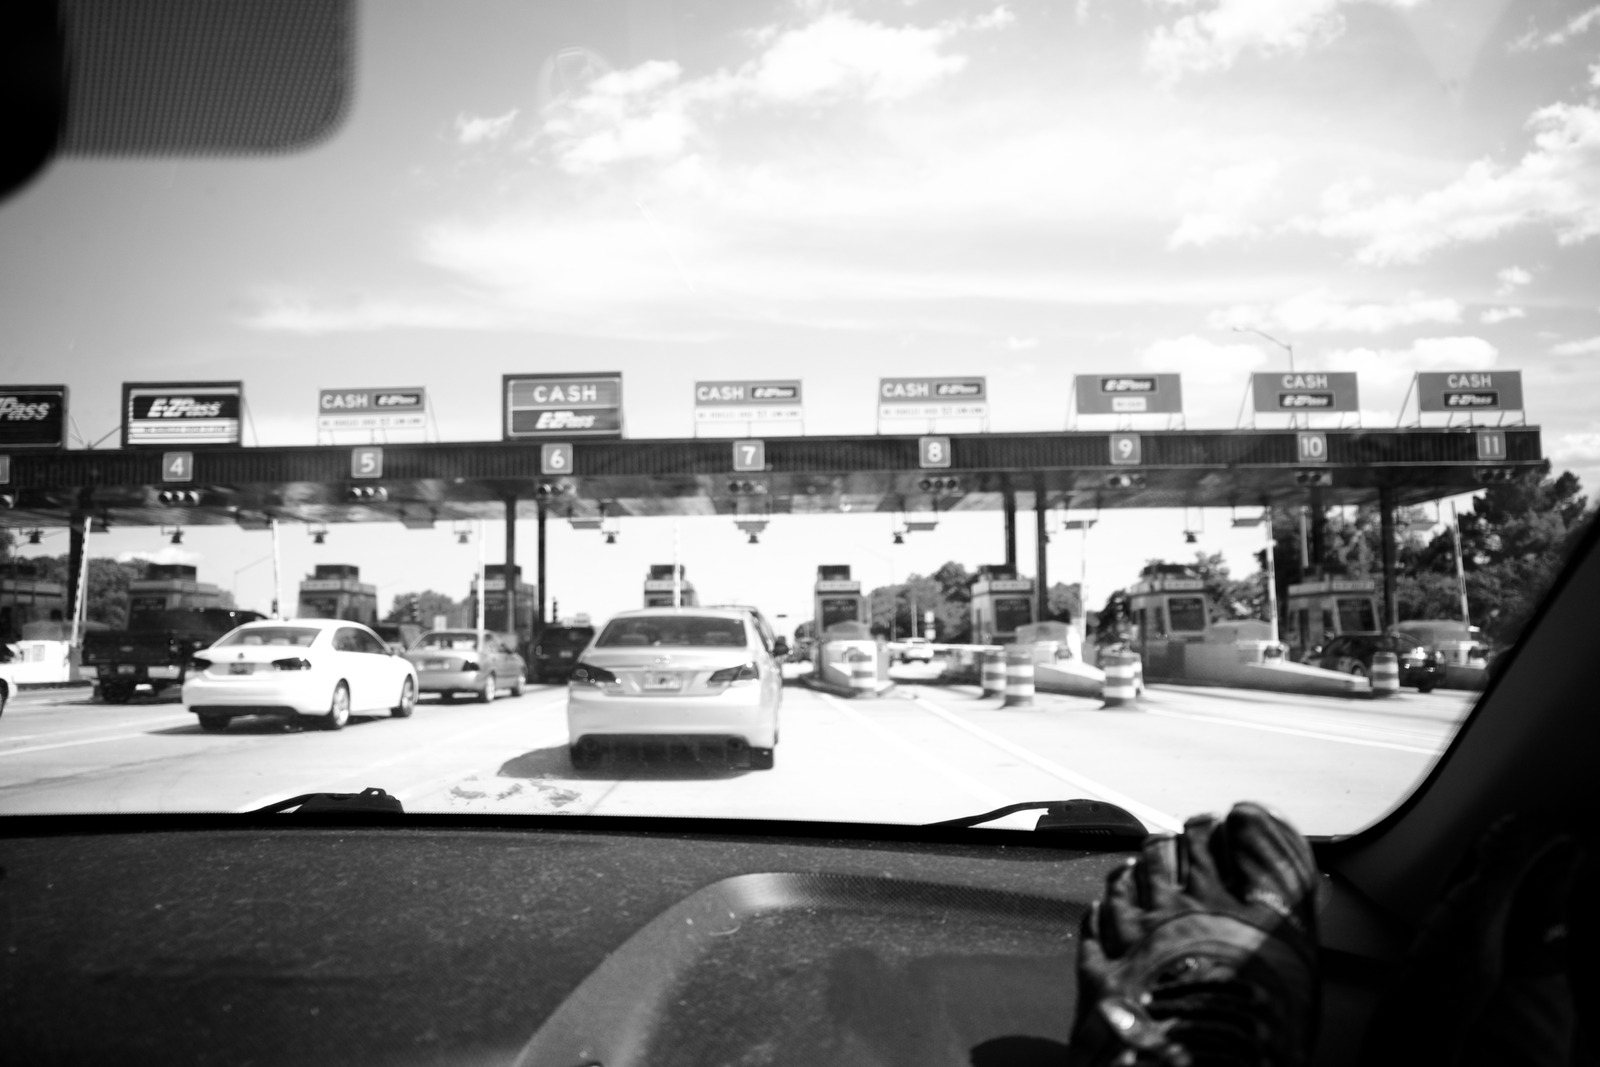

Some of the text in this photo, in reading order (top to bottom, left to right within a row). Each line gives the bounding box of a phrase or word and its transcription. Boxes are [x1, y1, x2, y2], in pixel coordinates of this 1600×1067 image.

[881, 383, 929, 398] CASH
[1281, 375, 1328, 389] CASH
[1447, 374, 1491, 388] CASH
[321, 393, 368, 409] CASH
[533, 385, 597, 403] CASH
[697, 385, 744, 401] CASH
[147, 397, 222, 418] E-ZPass
[927, 443, 943, 462] 8
[1117, 439, 1133, 458] 9
[1301, 437, 1323, 456] 10
[1482, 435, 1499, 454] 11
[360, 453, 375, 472] 5
[549, 450, 565, 469] 6
[741, 446, 756, 465] 7
[169, 457, 185, 476] 4
